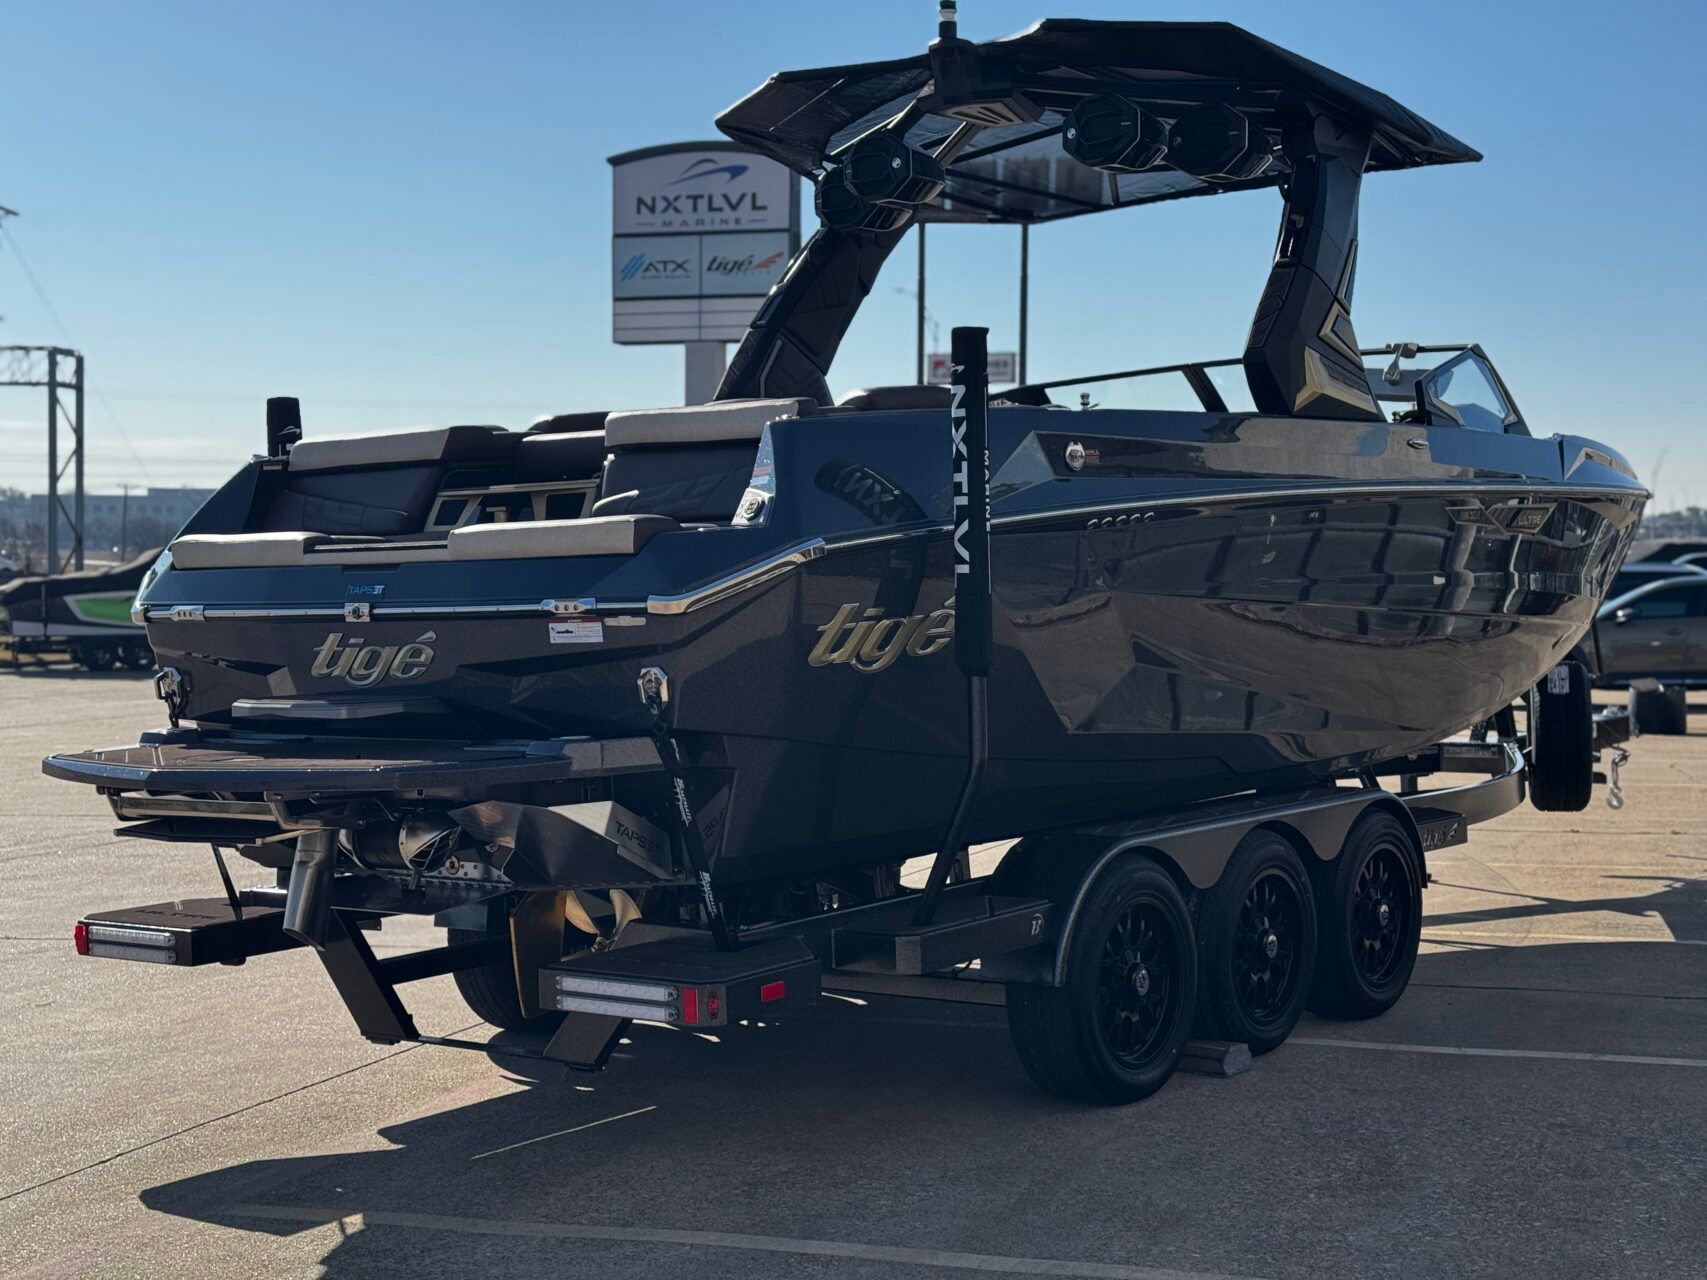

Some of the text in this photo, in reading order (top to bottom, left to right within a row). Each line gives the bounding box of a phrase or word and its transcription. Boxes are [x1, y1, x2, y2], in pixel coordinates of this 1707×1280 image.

[636, 192, 767, 215] NXTLVL
[661, 217, 742, 227] MARINE
[642, 259, 690, 273] ATX
[707, 254, 755, 276] tigé
[808, 596, 955, 674] tigé
[310, 629, 437, 688] tigé
